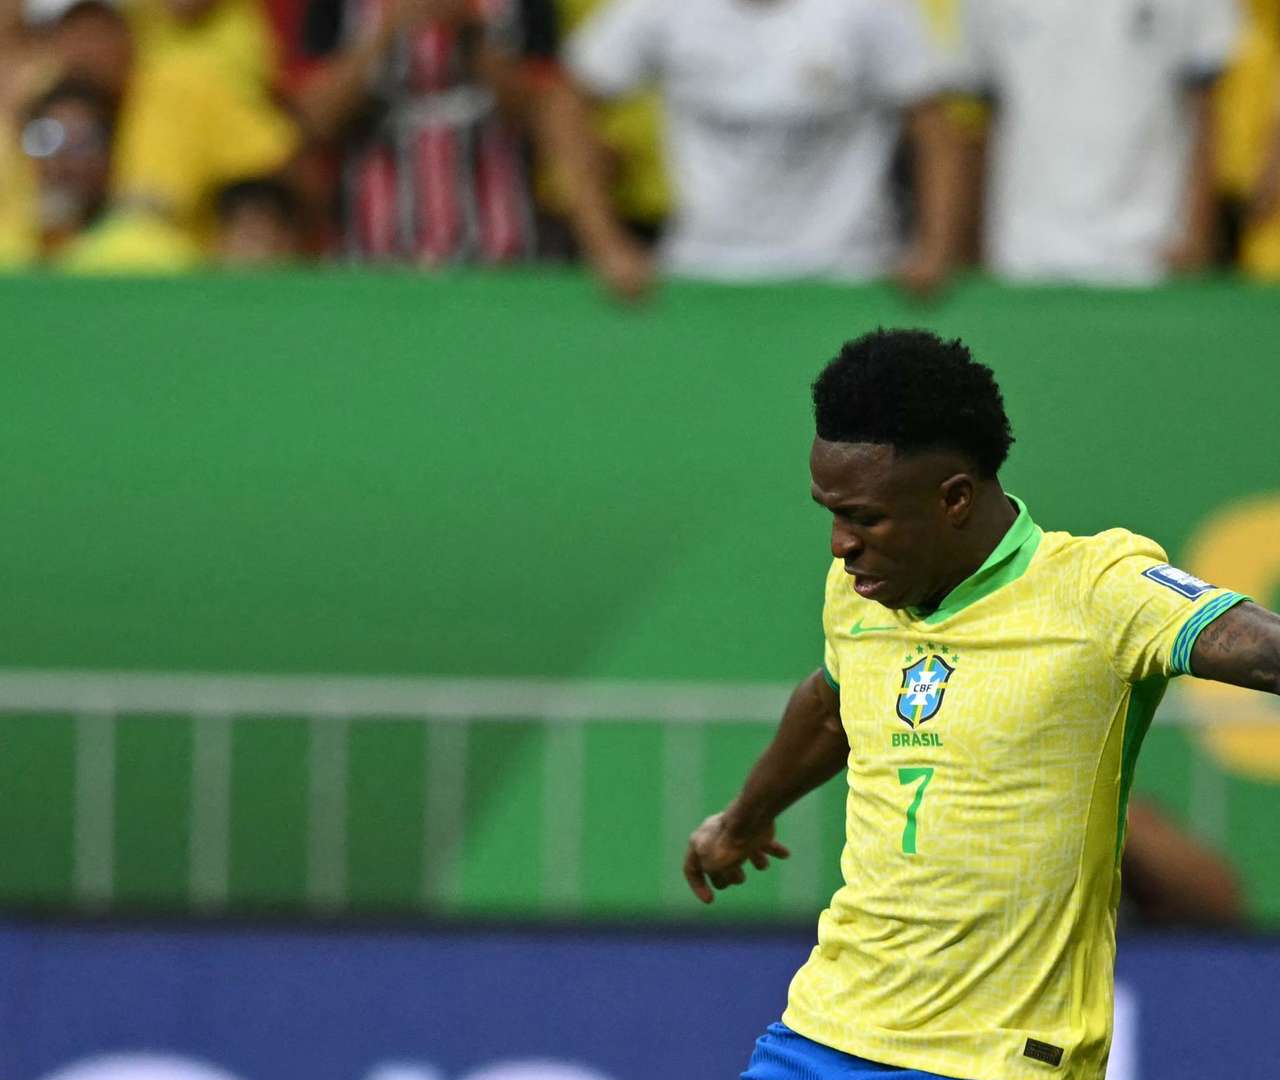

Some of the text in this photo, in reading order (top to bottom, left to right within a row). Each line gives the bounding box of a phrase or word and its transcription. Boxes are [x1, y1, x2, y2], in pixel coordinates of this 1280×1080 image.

[912, 683, 933, 694] CBF
[891, 732, 944, 748] BRASIL
[898, 767, 935, 855] 7
